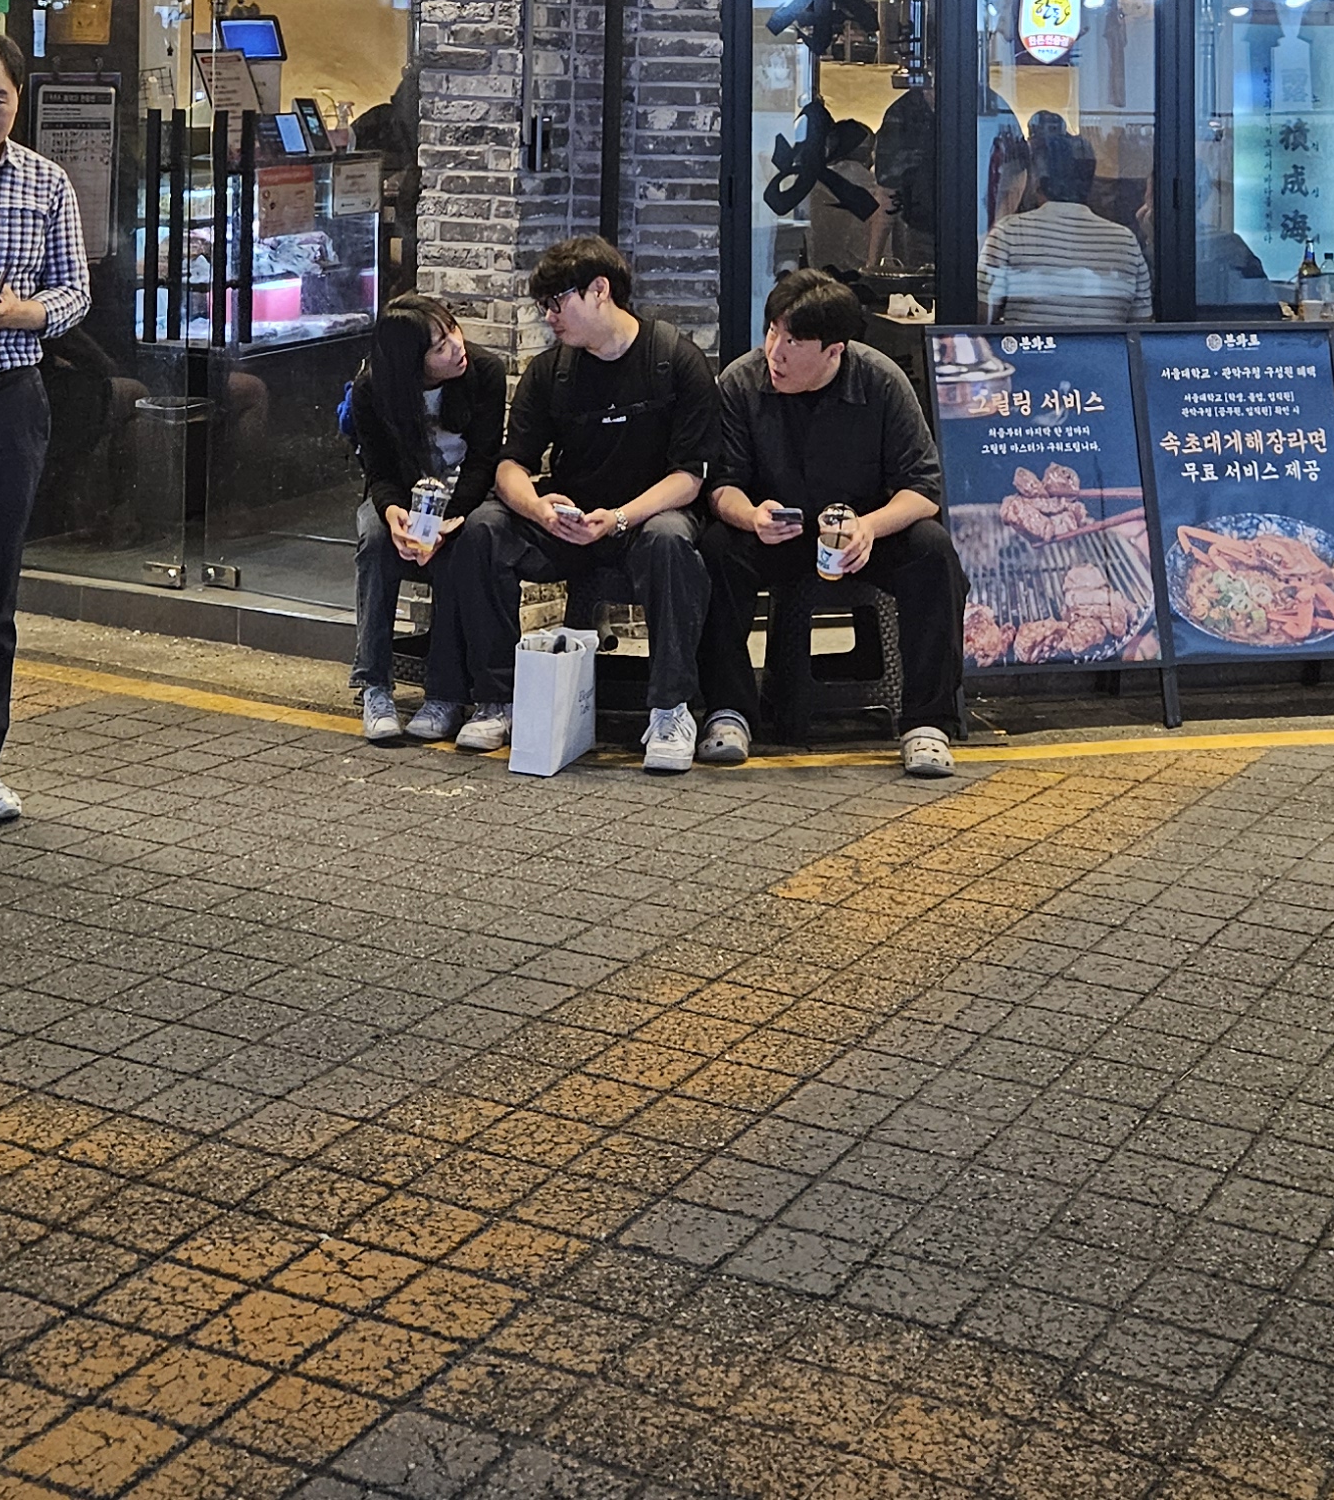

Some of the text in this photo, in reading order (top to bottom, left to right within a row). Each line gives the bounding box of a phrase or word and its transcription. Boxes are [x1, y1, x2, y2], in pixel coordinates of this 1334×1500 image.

[969, 389, 1105, 416] 그릴링 서비스
[1181, 460, 1321, 483] 무료 서비스 제공
